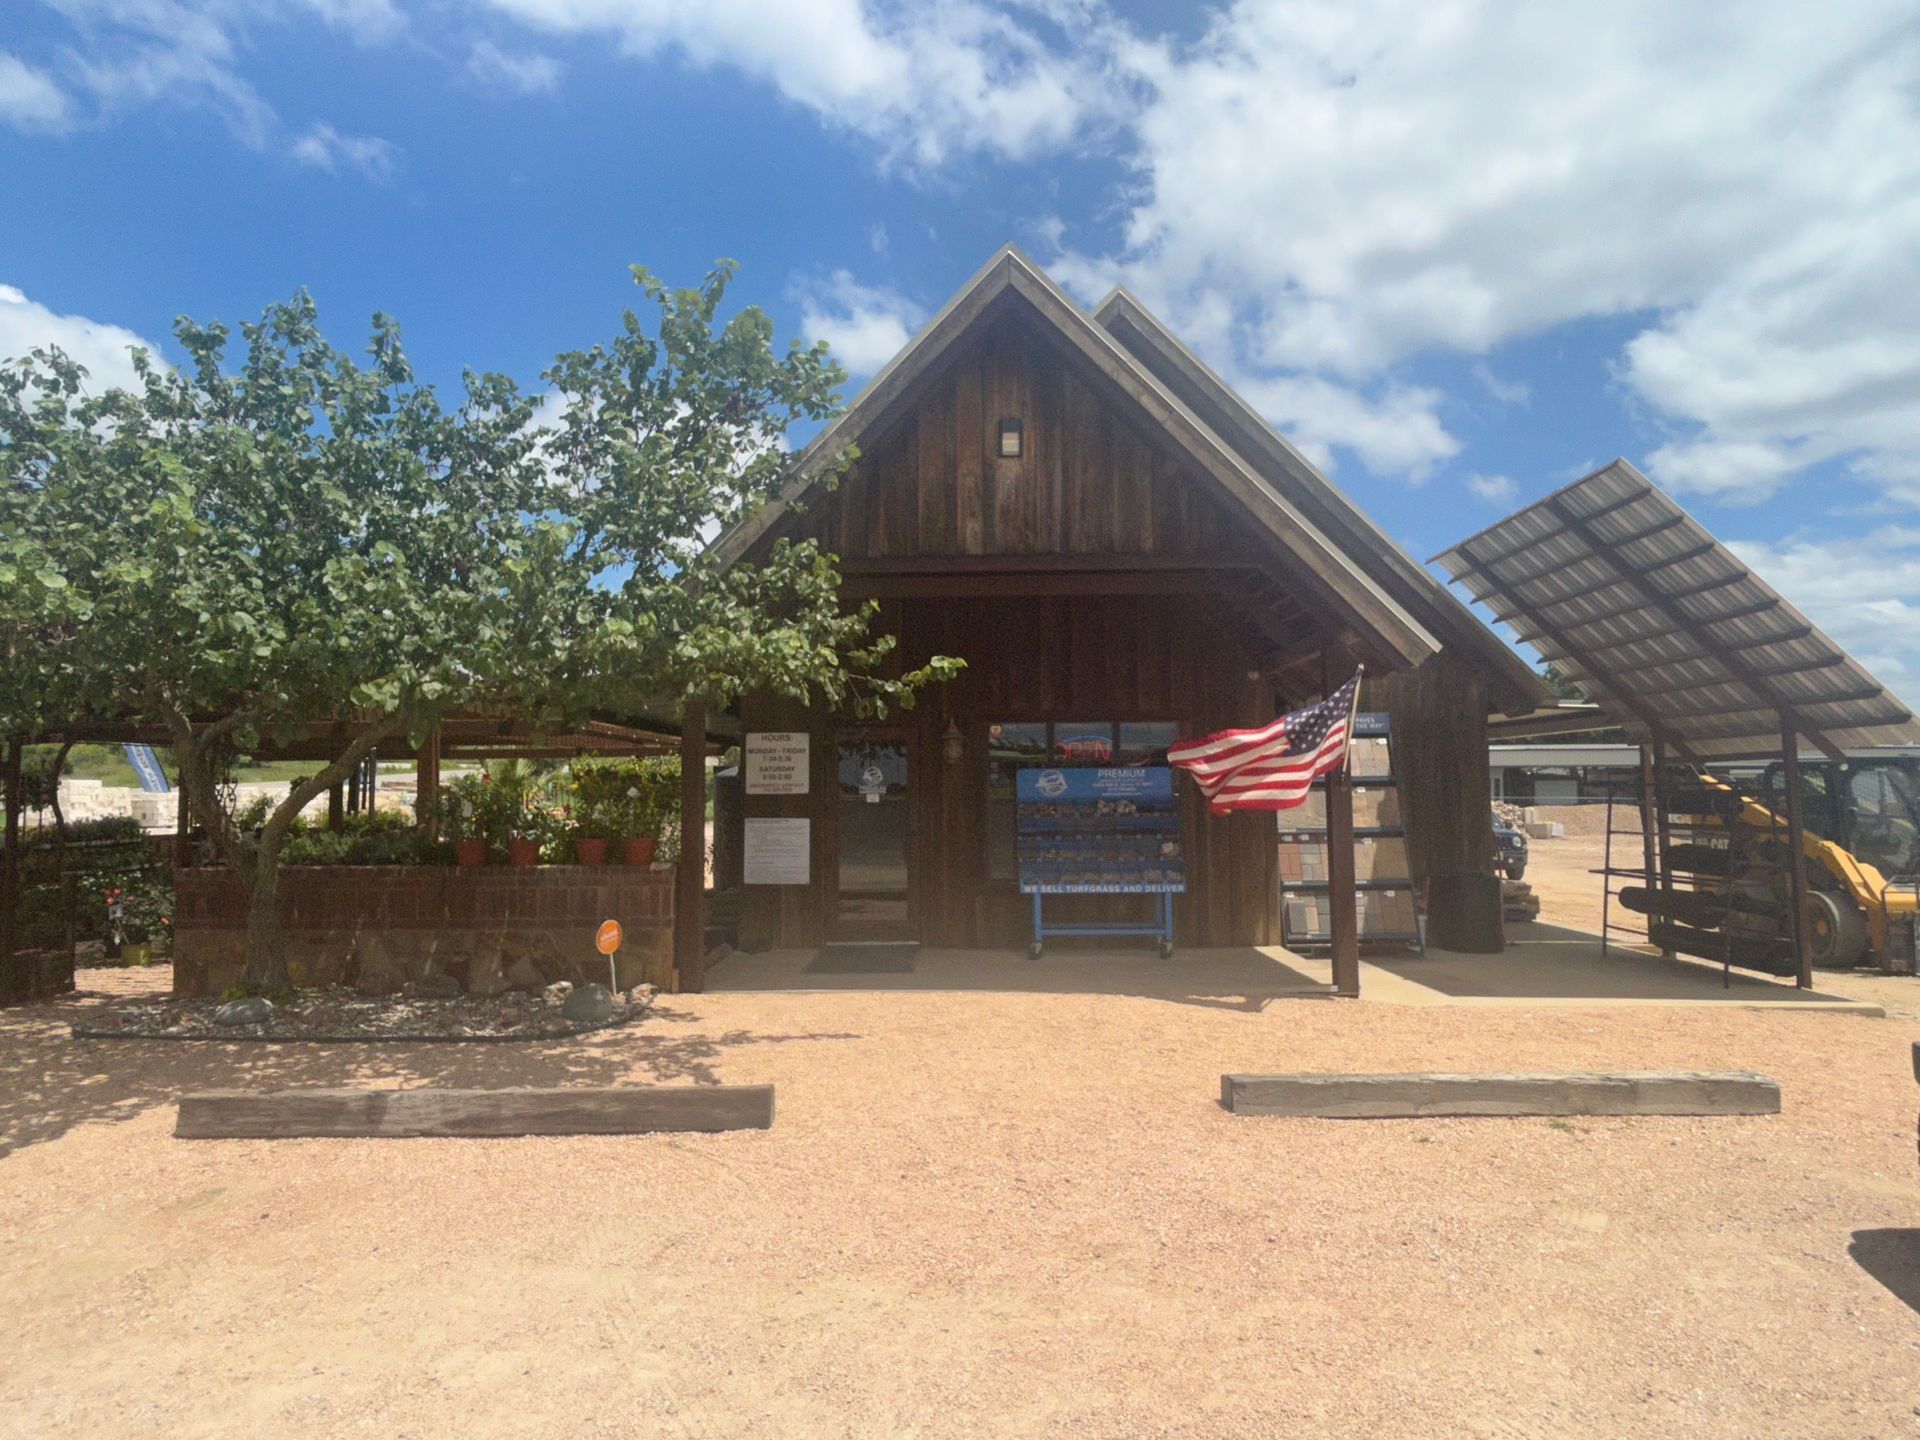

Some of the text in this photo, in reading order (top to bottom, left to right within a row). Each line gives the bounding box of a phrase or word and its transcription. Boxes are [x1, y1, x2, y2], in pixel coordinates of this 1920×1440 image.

[1097, 768, 1146, 777] PREMIUM
[1711, 838, 1729, 850] CAT
[1023, 884, 1184, 893] WE SELL TURFGRASS AND DELIVER
